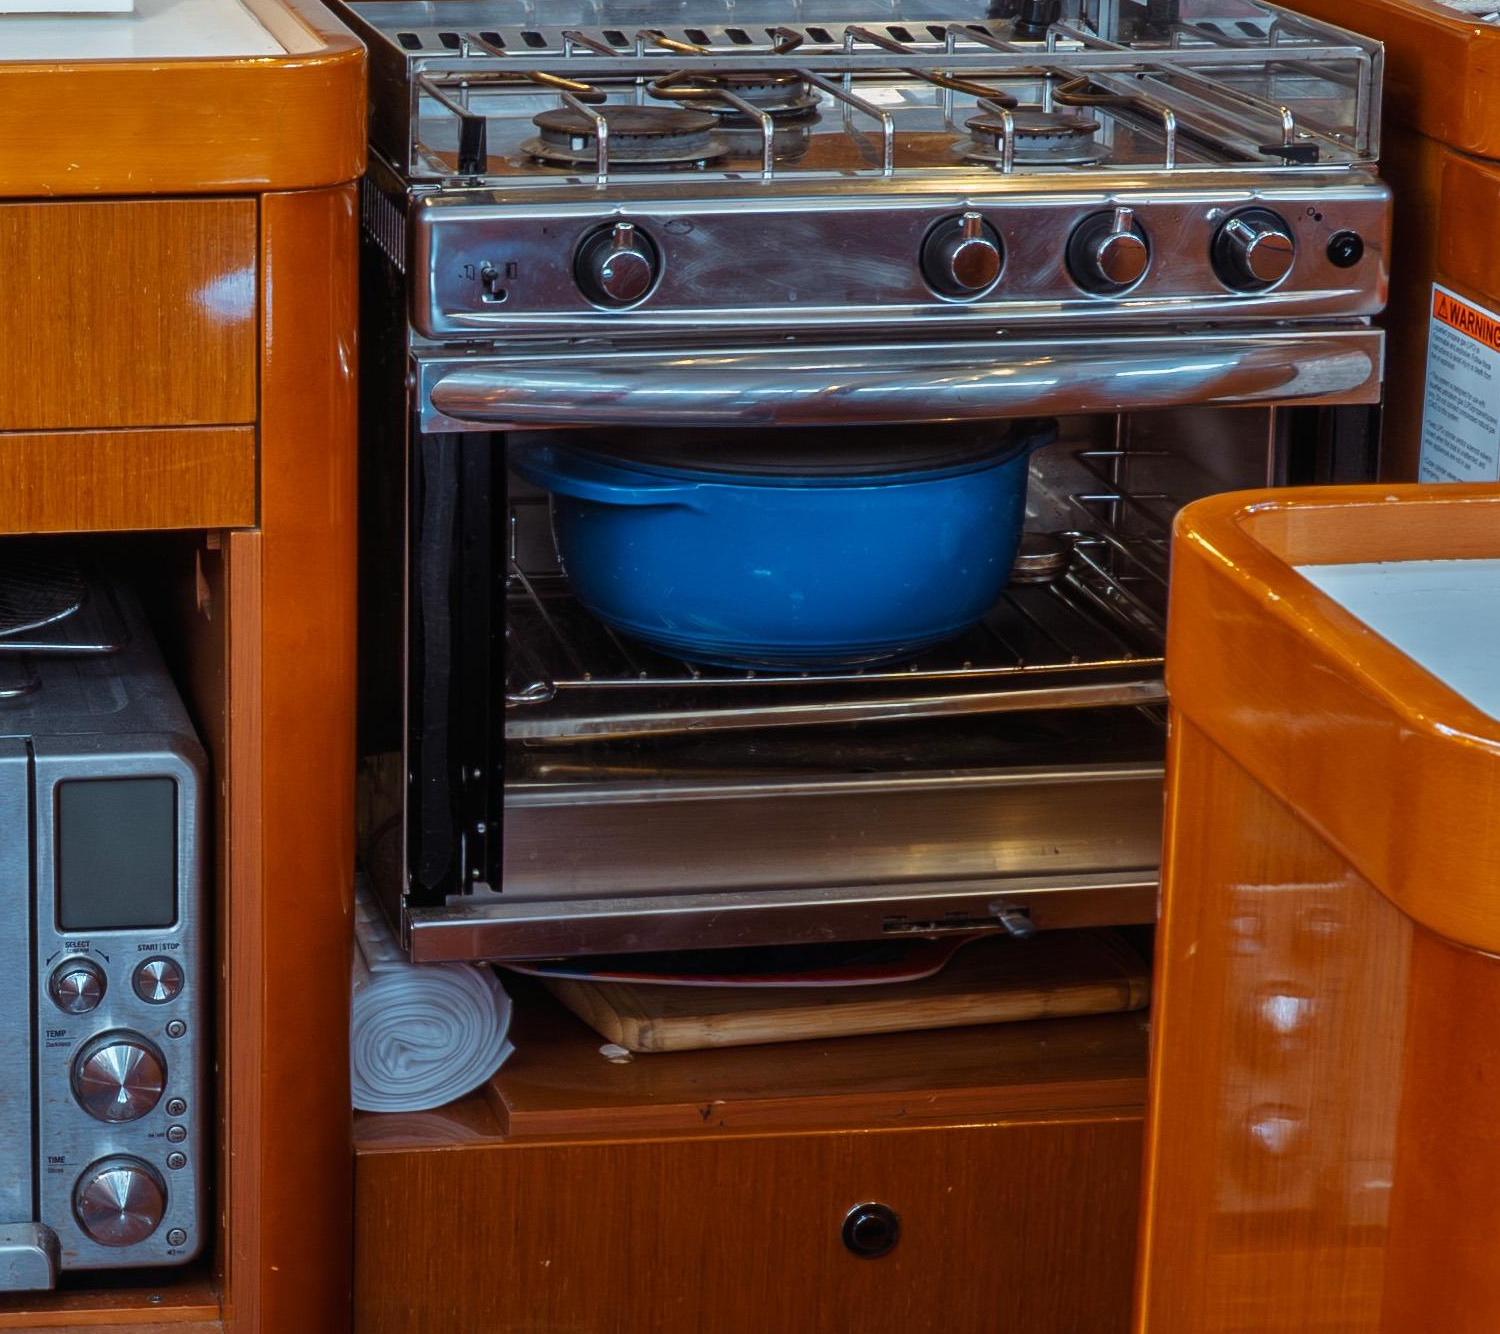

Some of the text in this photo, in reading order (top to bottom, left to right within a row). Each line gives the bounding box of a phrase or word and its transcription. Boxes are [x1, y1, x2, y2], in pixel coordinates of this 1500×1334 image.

[65, 941, 90, 949] SELECT
[46, 1030, 66, 1038] TEMP
[47, 1156, 66, 1164] TIME
